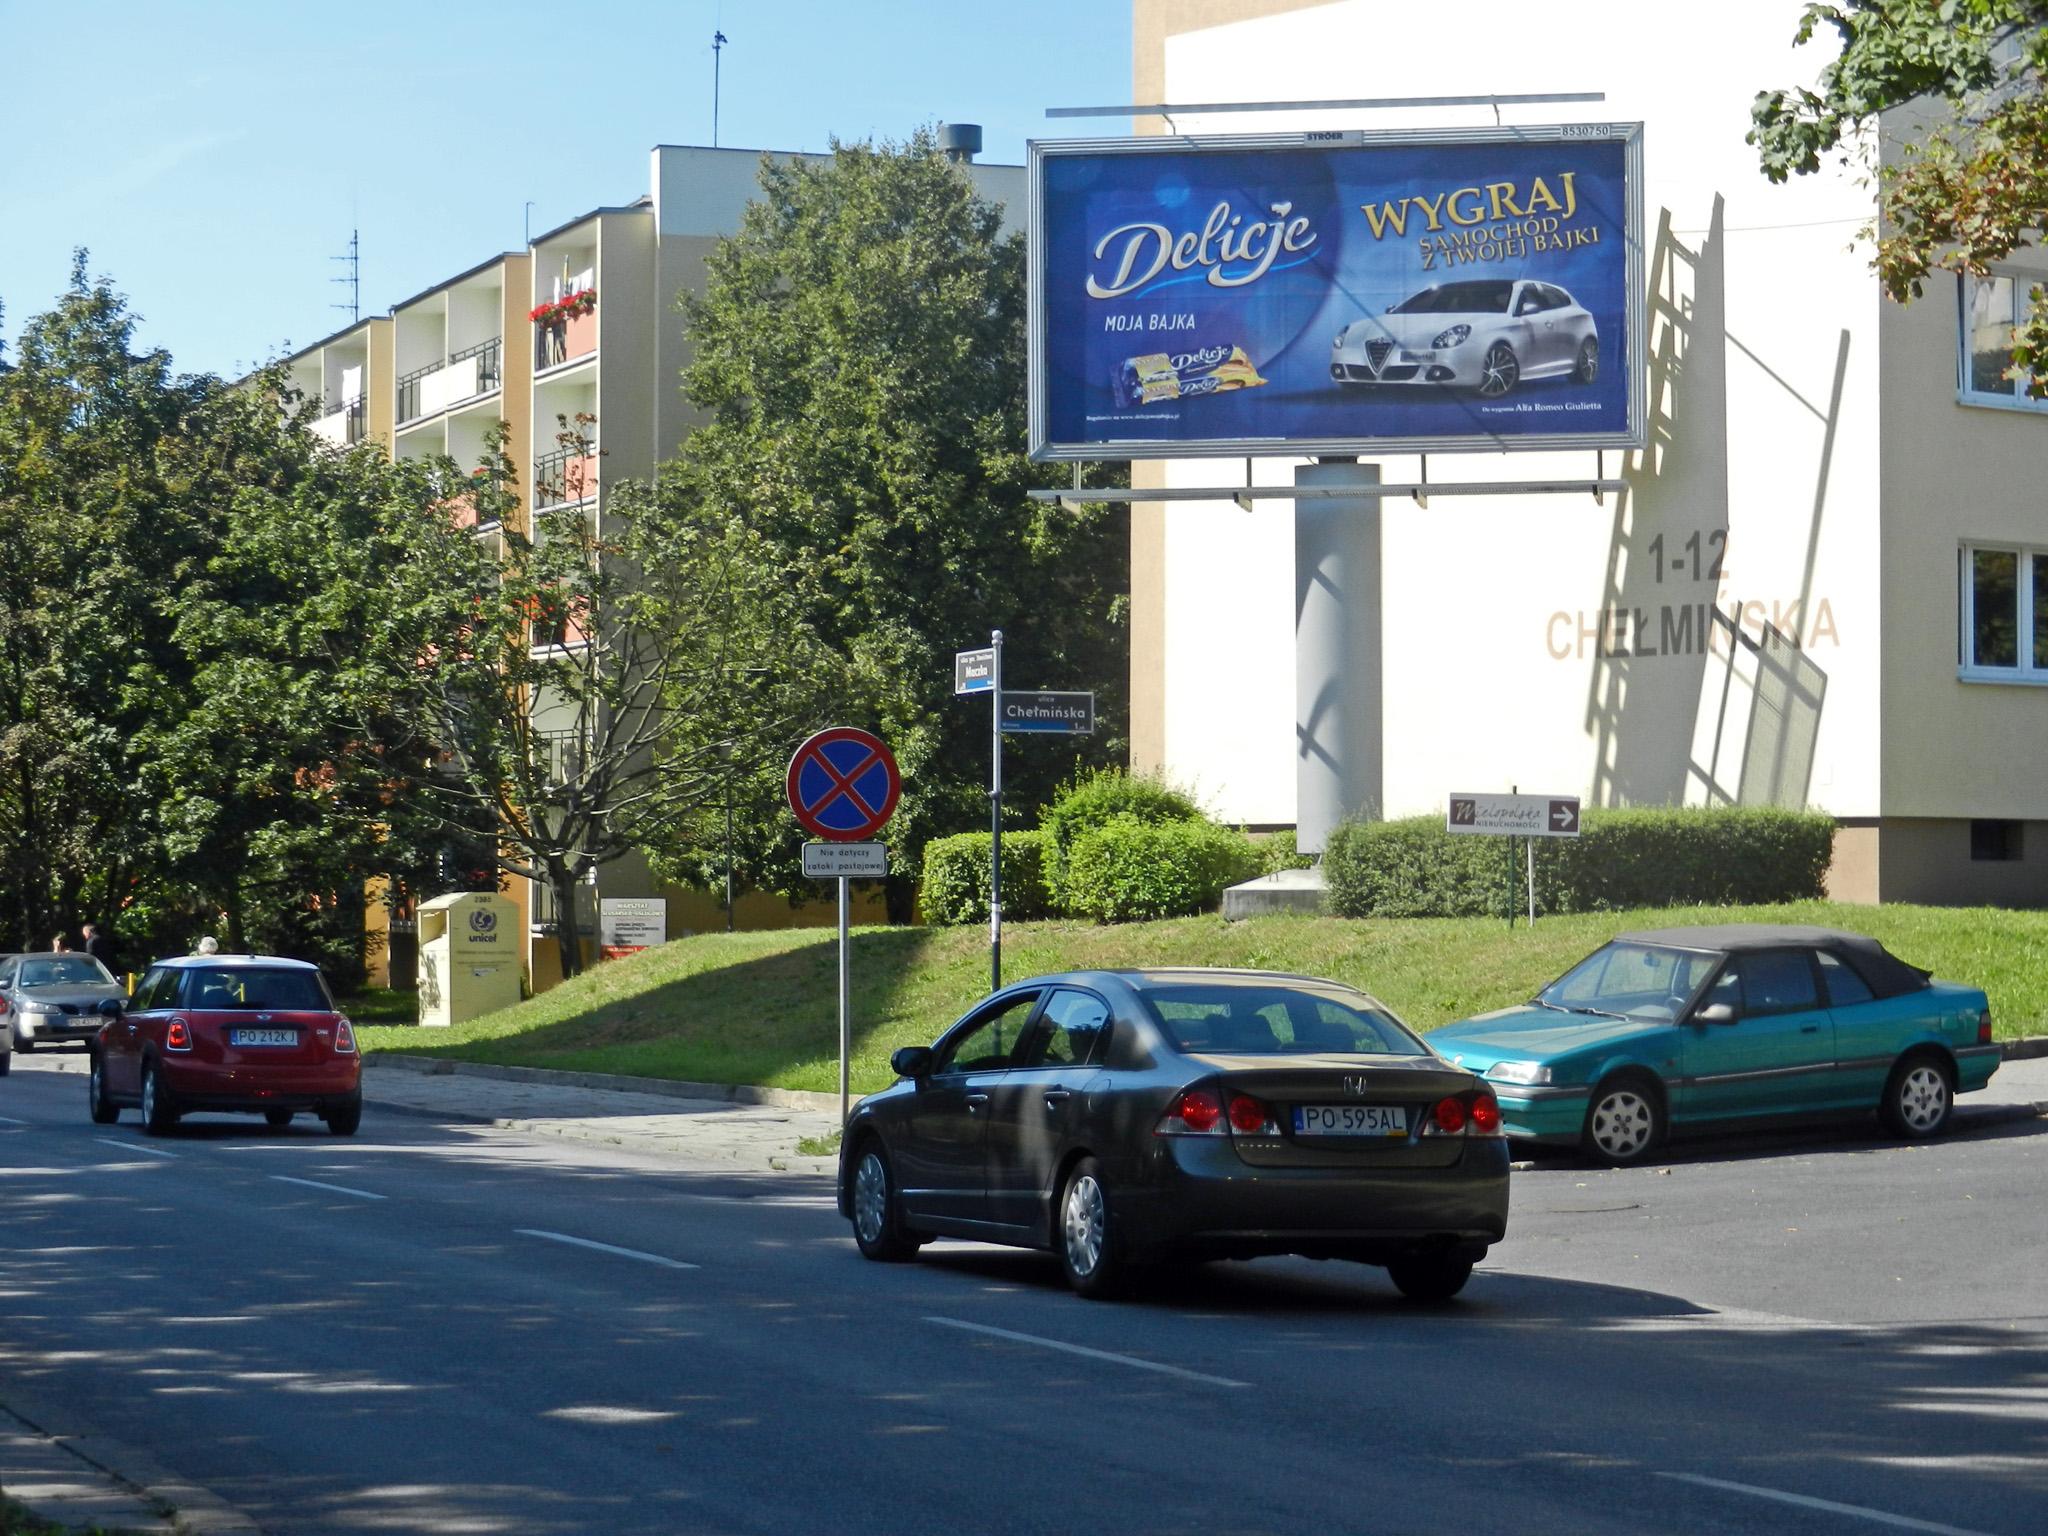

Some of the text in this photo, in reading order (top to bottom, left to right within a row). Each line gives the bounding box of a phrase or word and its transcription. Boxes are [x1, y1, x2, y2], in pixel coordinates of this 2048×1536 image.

[1562, 126, 1609, 136] 8530750
[1361, 171, 1577, 240] WYGRAJ
[1419, 215, 1559, 252] SAMOCHÓD
[1086, 201, 1317, 299] Delicje
[1421, 226, 1600, 271] Z TWOJEJ BAJKI
[1105, 313, 1196, 331] MOJA BAJKA
[1515, 403, 1532, 412] Alfa
[1534, 403, 1564, 411] Romeo
[1565, 401, 1602, 411] Giulietta
[1648, 528, 1729, 583] 1-12
[1546, 589, 1840, 660] CHEŁMIŃSKA
[1007, 705, 1086, 718] Chełmińska
[1475, 820, 1540, 829] NIERUCHOMOŚCI
[839, 849, 869, 858] dotyczy
[240, 1031, 256, 1042] PO
[1307, 1108, 1335, 1128] PO
[1343, 1108, 1403, 1129] 595AL
